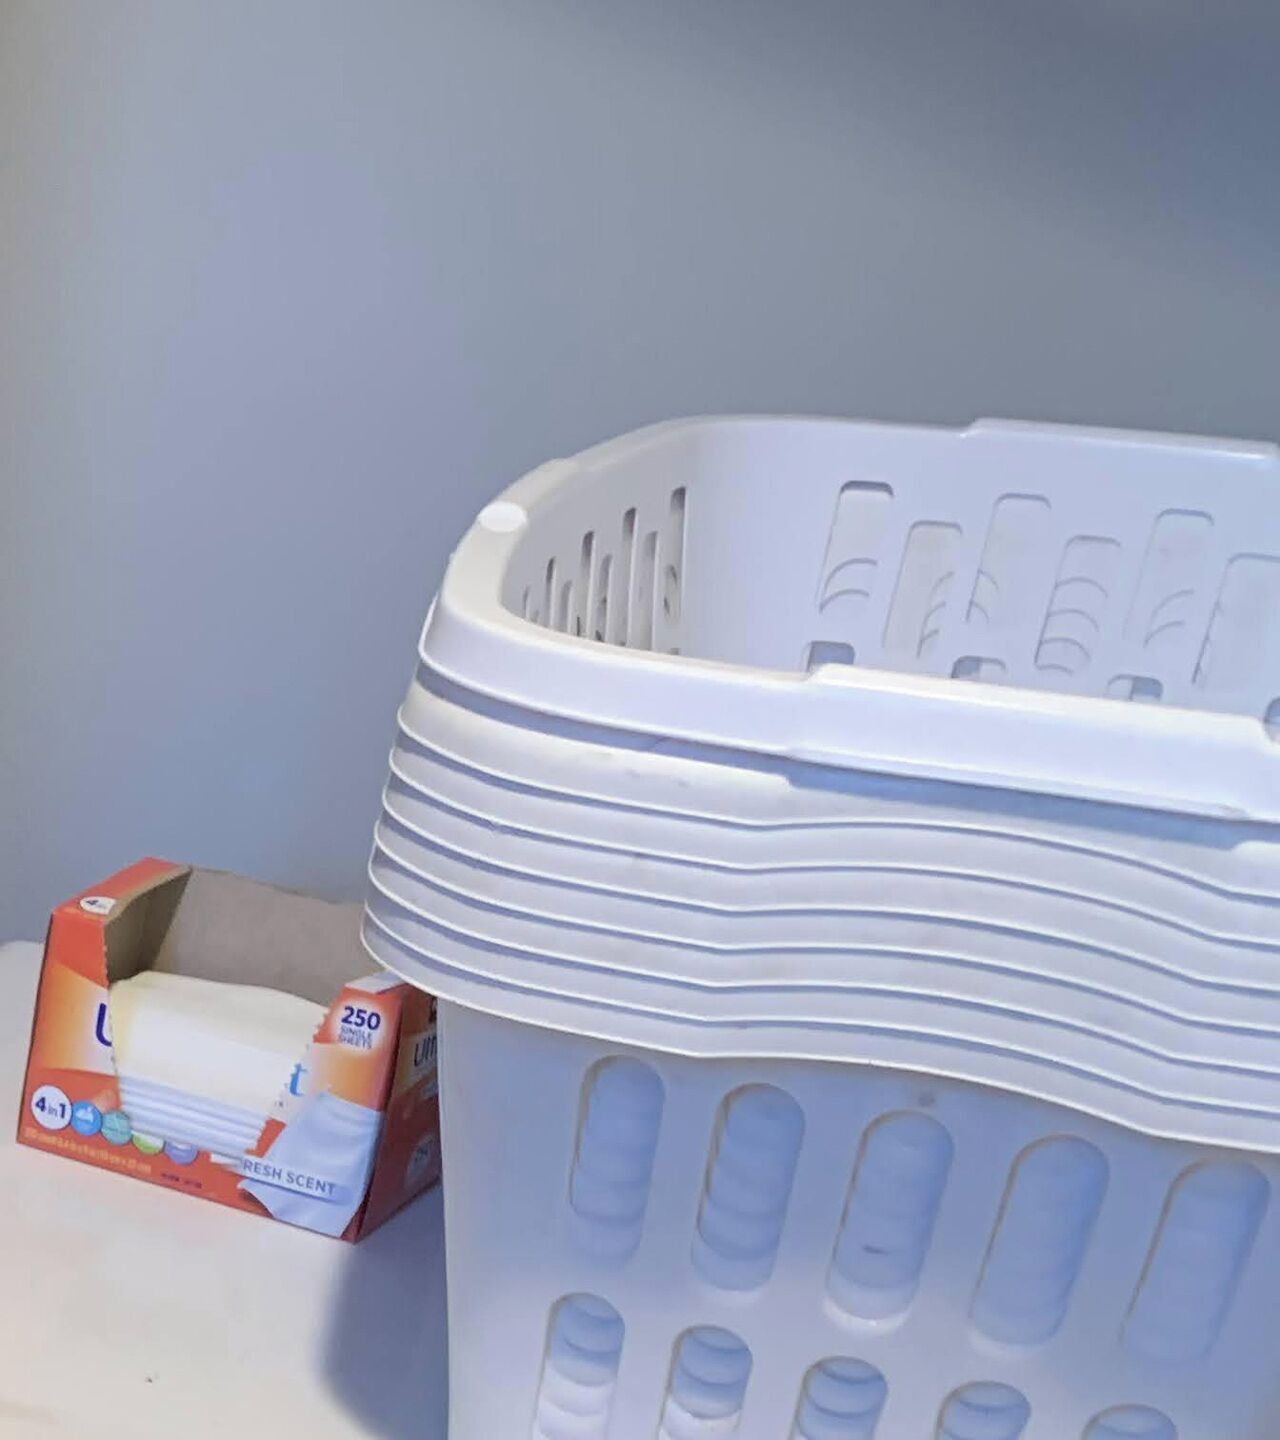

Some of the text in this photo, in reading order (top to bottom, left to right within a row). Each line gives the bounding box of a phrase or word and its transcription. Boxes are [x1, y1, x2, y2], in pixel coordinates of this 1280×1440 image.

[341, 1004, 382, 1031] 250
[340, 1025, 373, 1041] SINGLE
[242, 1159, 337, 1196] RESH SCENT
